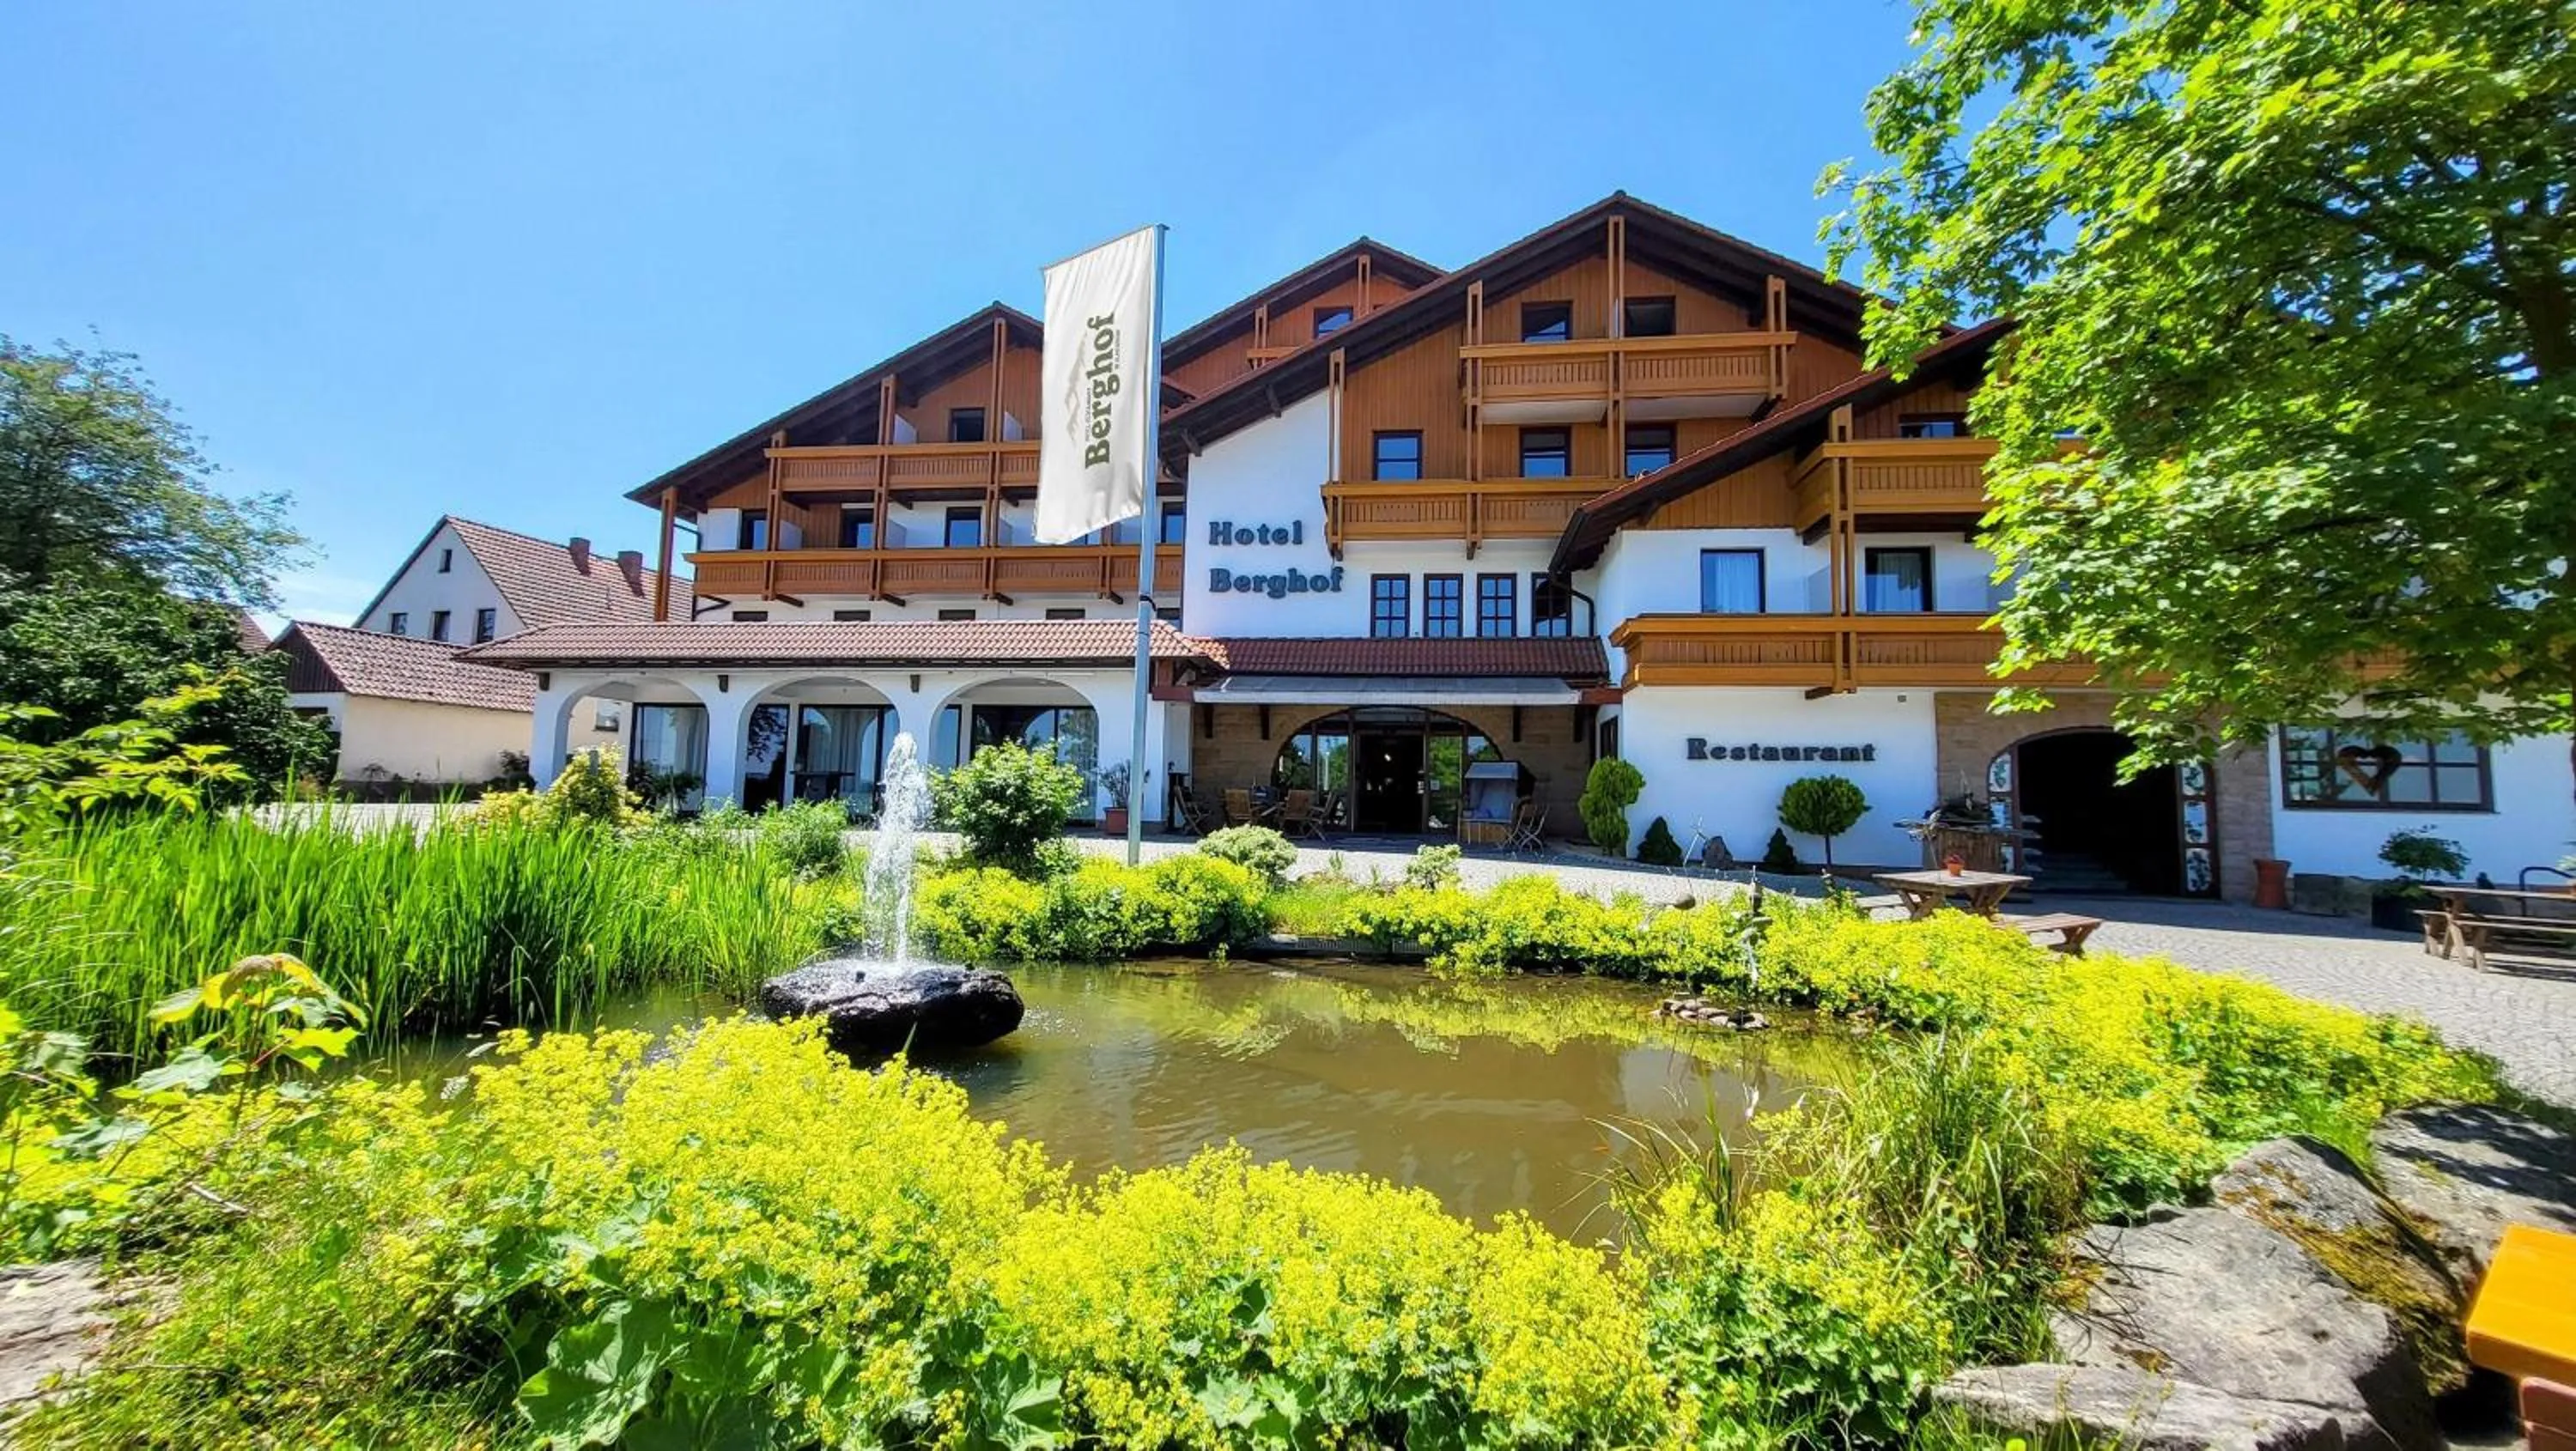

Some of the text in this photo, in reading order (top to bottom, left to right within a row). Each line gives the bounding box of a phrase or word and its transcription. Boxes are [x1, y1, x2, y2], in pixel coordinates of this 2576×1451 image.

[1085, 311, 1121, 470] Berghof
[1208, 519, 1303, 546] Hotel
[1208, 566, 1345, 600] Berghof
[1686, 737, 1876, 762] Restaurant
